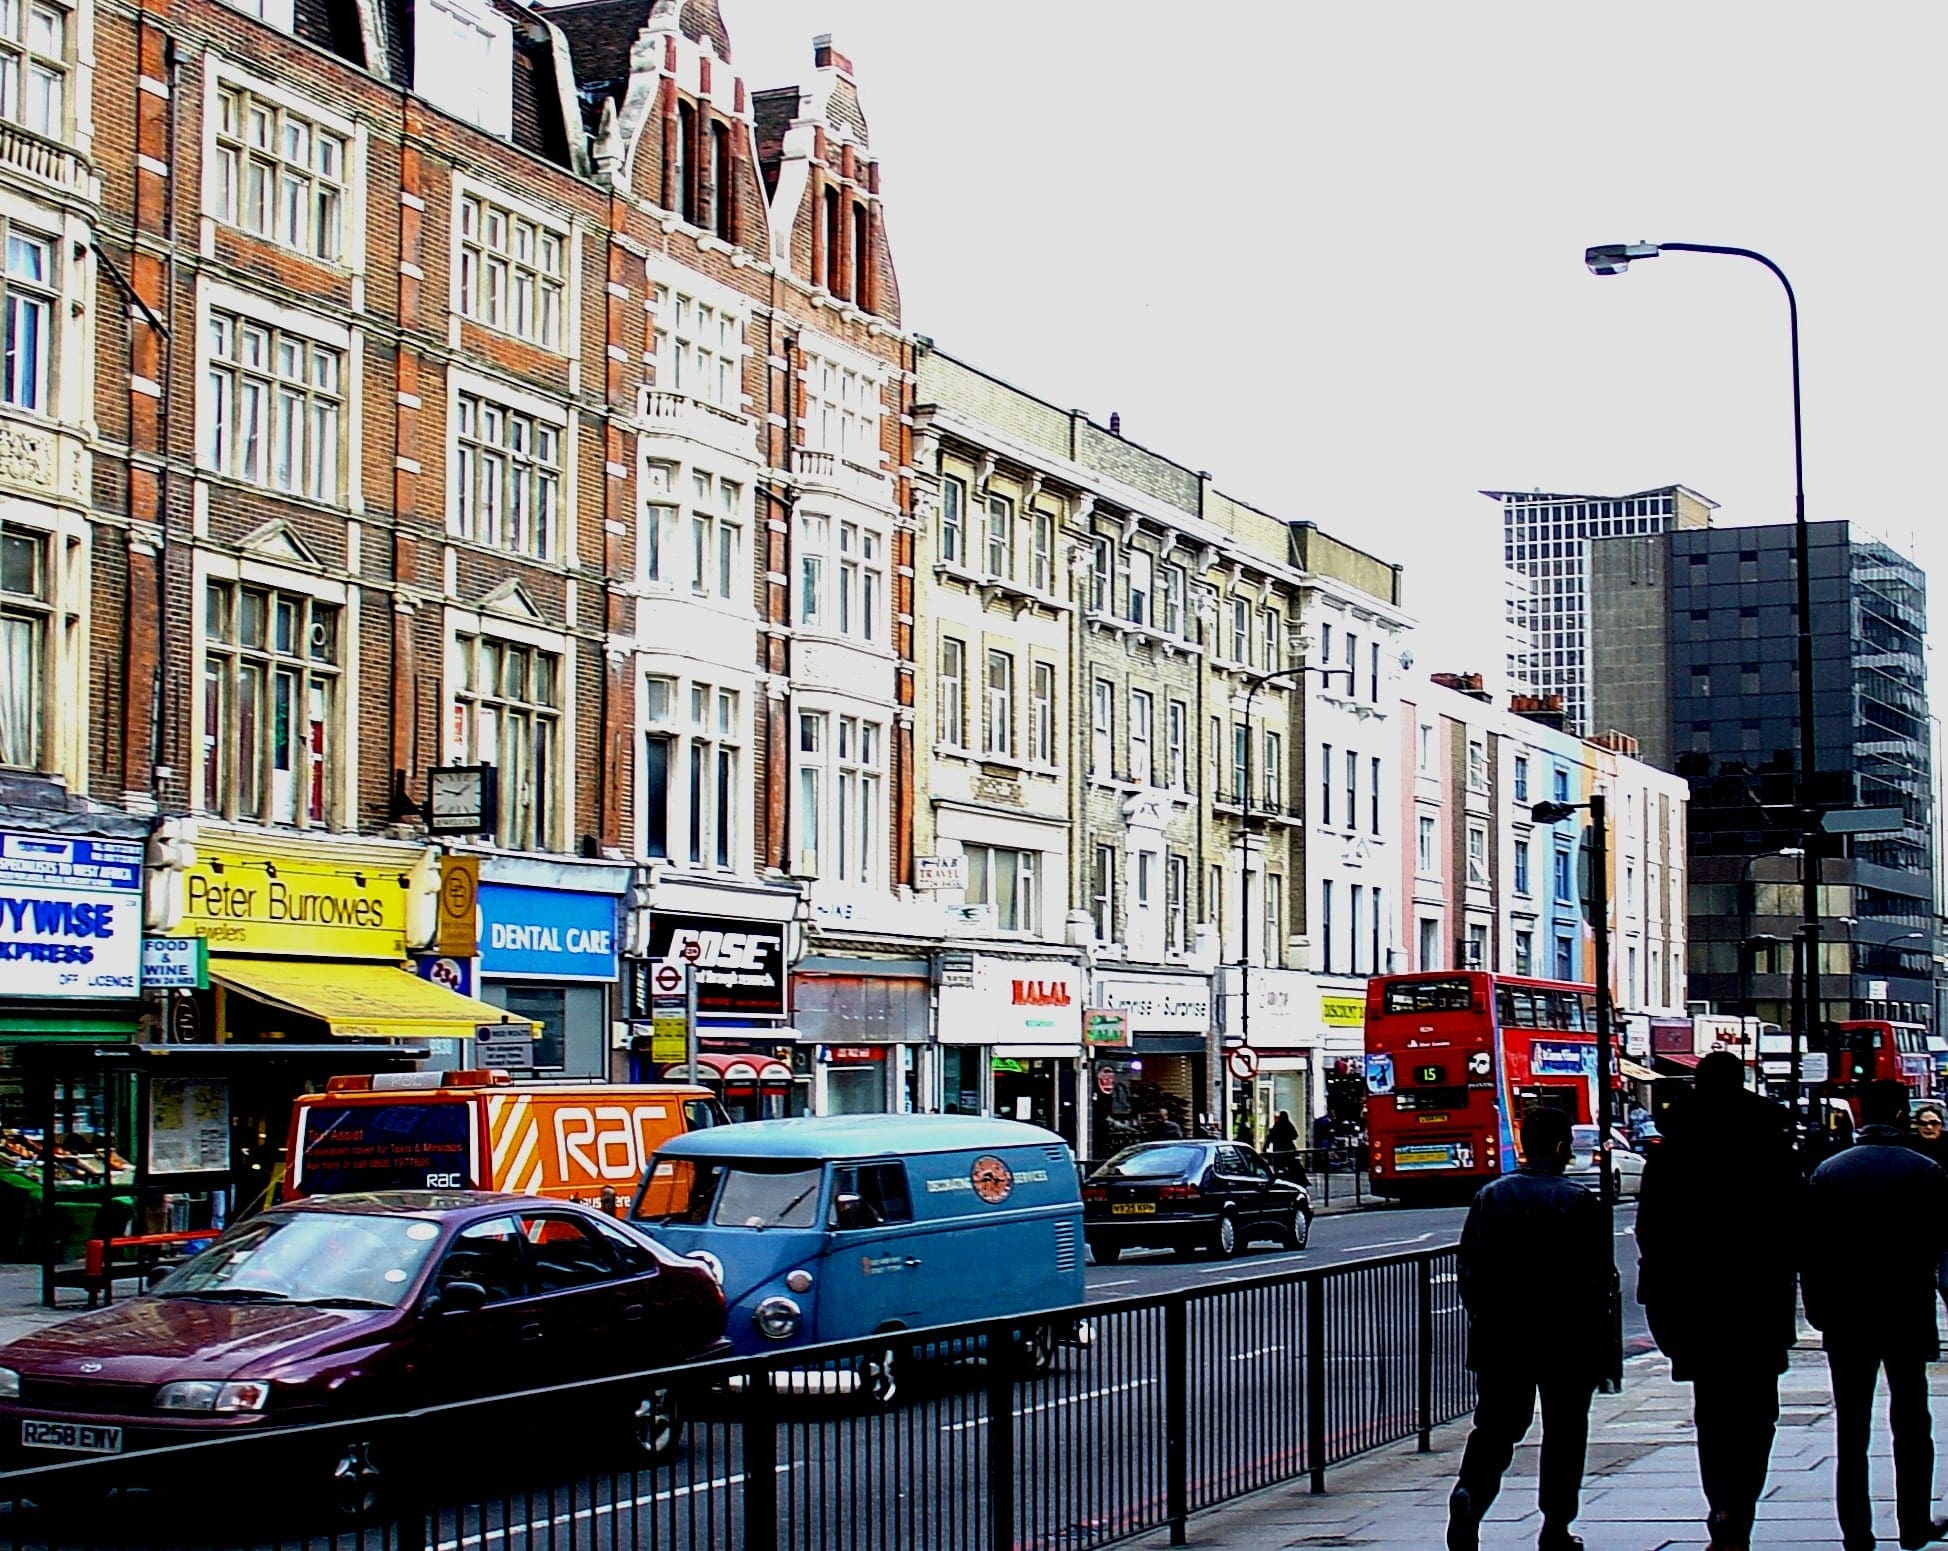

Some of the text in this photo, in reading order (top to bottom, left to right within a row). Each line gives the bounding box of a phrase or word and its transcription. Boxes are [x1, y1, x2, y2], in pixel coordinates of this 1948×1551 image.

[189, 875, 383, 926] Peter Burrowes
[0, 897, 114, 938] YWISE
[144, 940, 188, 951] FOOD
[491, 923, 562, 952] DENTAL
[565, 928, 610, 955] CARE
[161, 953, 171, 963] &
[144, 965, 188, 975] WINE
[59, 974, 134, 987] OFF LICENCE
[1012, 979, 1071, 1006] HALAL
[1424, 1068, 1437, 1081] 15
[24, 1423, 76, 1446] R258
